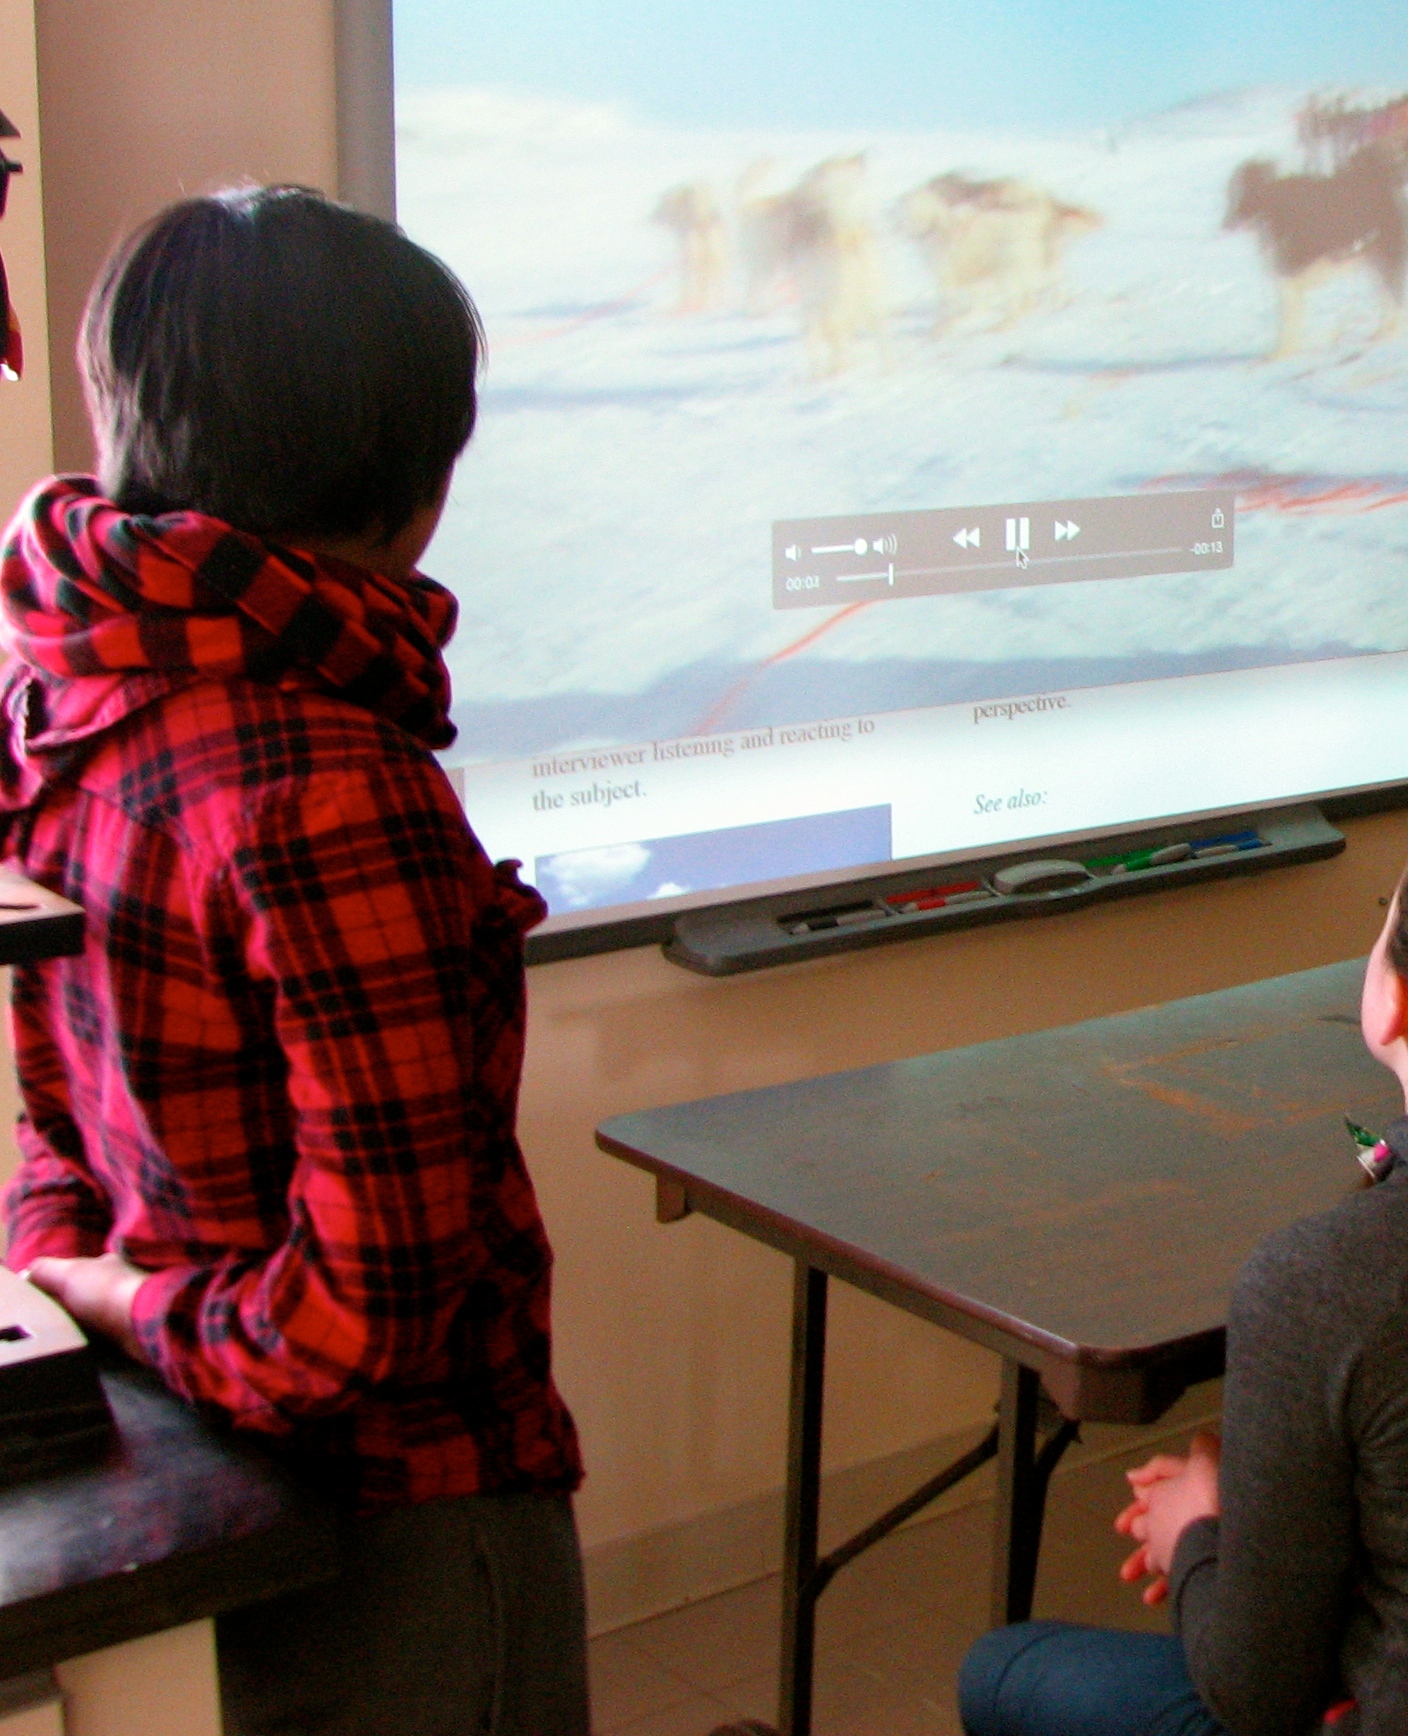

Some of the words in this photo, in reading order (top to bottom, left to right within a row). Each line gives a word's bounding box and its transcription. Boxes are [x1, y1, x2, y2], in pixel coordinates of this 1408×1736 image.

[973, 696, 1071, 725] perspective.
[533, 749, 646, 778] interviewer
[653, 735, 735, 757] listening
[740, 727, 774, 749] and
[780, 720, 852, 742] reacting
[857, 717, 875, 735] to
[533, 789, 564, 812] the
[571, 780, 647, 807] subject.
[973, 793, 1003, 815] See
[1006, 788, 1048, 810] also:
